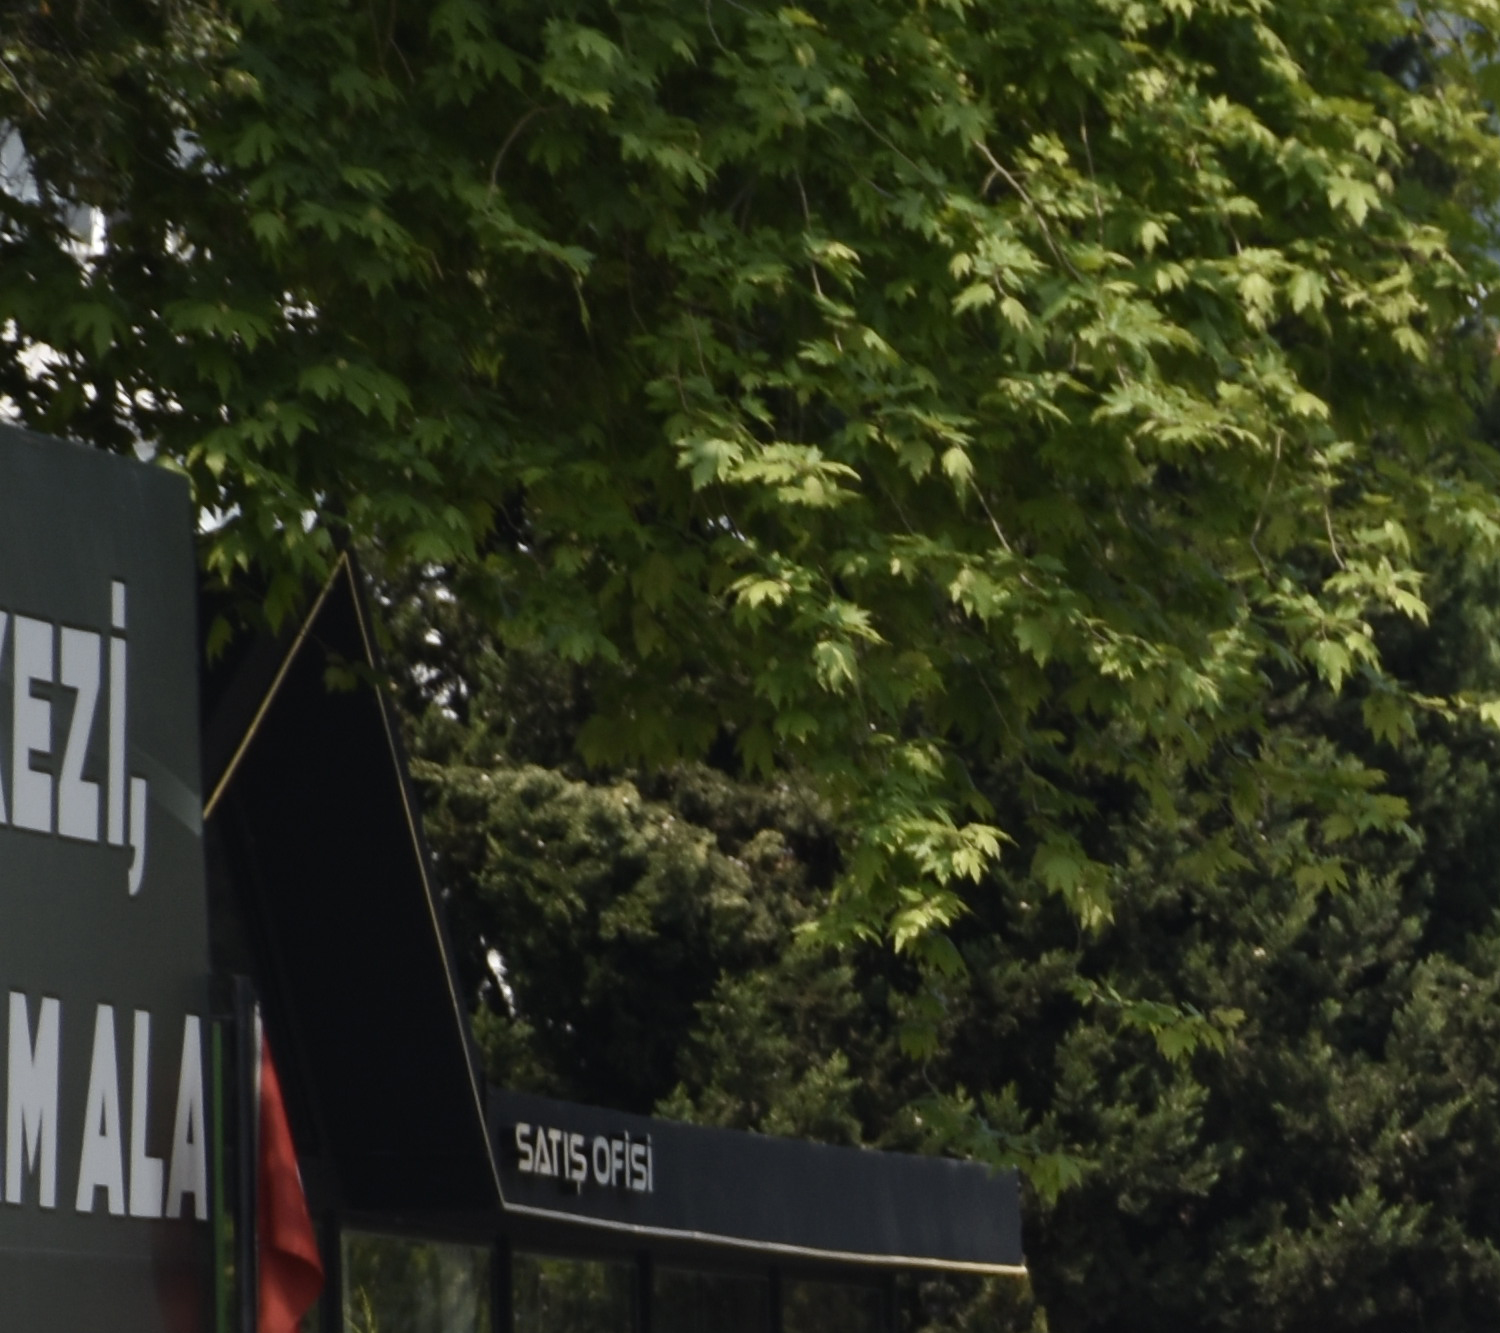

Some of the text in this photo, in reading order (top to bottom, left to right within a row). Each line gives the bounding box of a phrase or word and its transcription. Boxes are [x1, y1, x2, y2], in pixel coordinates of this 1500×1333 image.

[0, 577, 147, 896] EZİ,
[515, 1121, 654, 1196] SATIŞ OFİSİ
